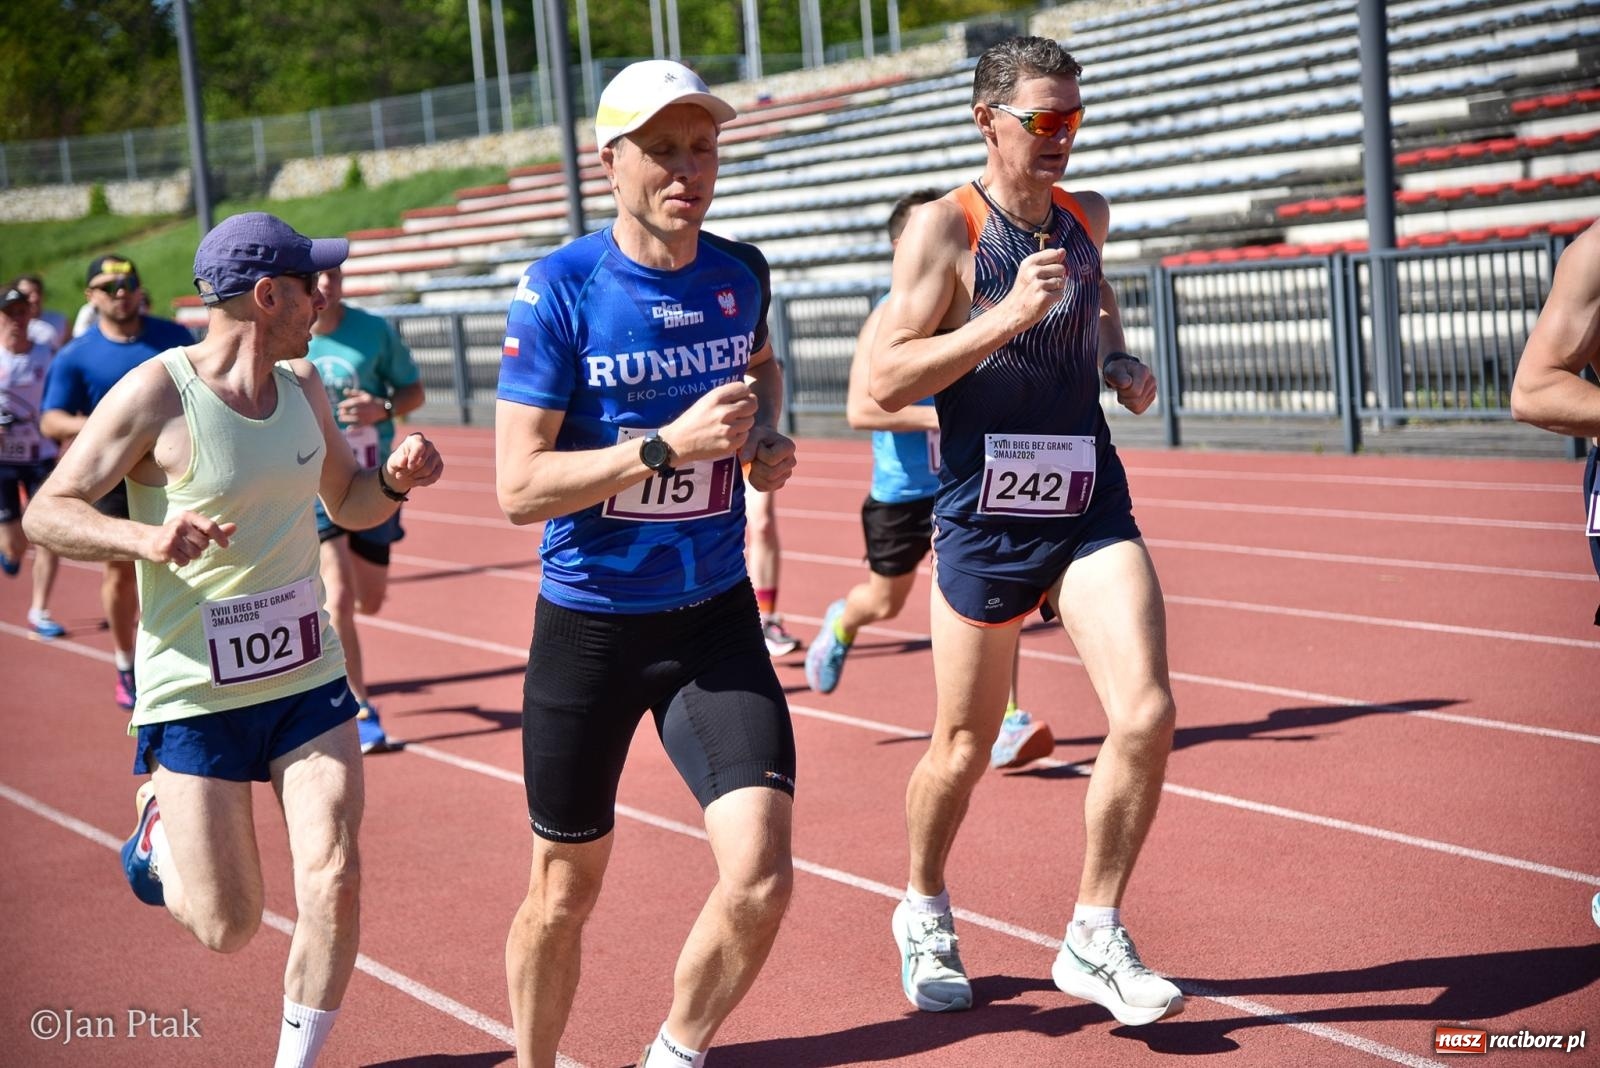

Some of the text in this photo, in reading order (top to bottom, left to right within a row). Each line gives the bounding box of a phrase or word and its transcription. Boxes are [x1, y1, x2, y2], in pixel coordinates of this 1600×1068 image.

[587, 331, 755, 387] RUNNERS
[627, 382, 707, 402] EKO-OKNA
[993, 440, 1073, 451] XVIII BIEG BEZ GRANIC
[993, 450, 1035, 460] 3MAJA2026
[640, 468, 695, 505] 115
[996, 471, 1063, 501] 242
[210, 590, 296, 618] XVIII BIEG BEZ GRANIC
[211, 611, 260, 628] 3MAJA2026
[228, 626, 293, 669] 102
